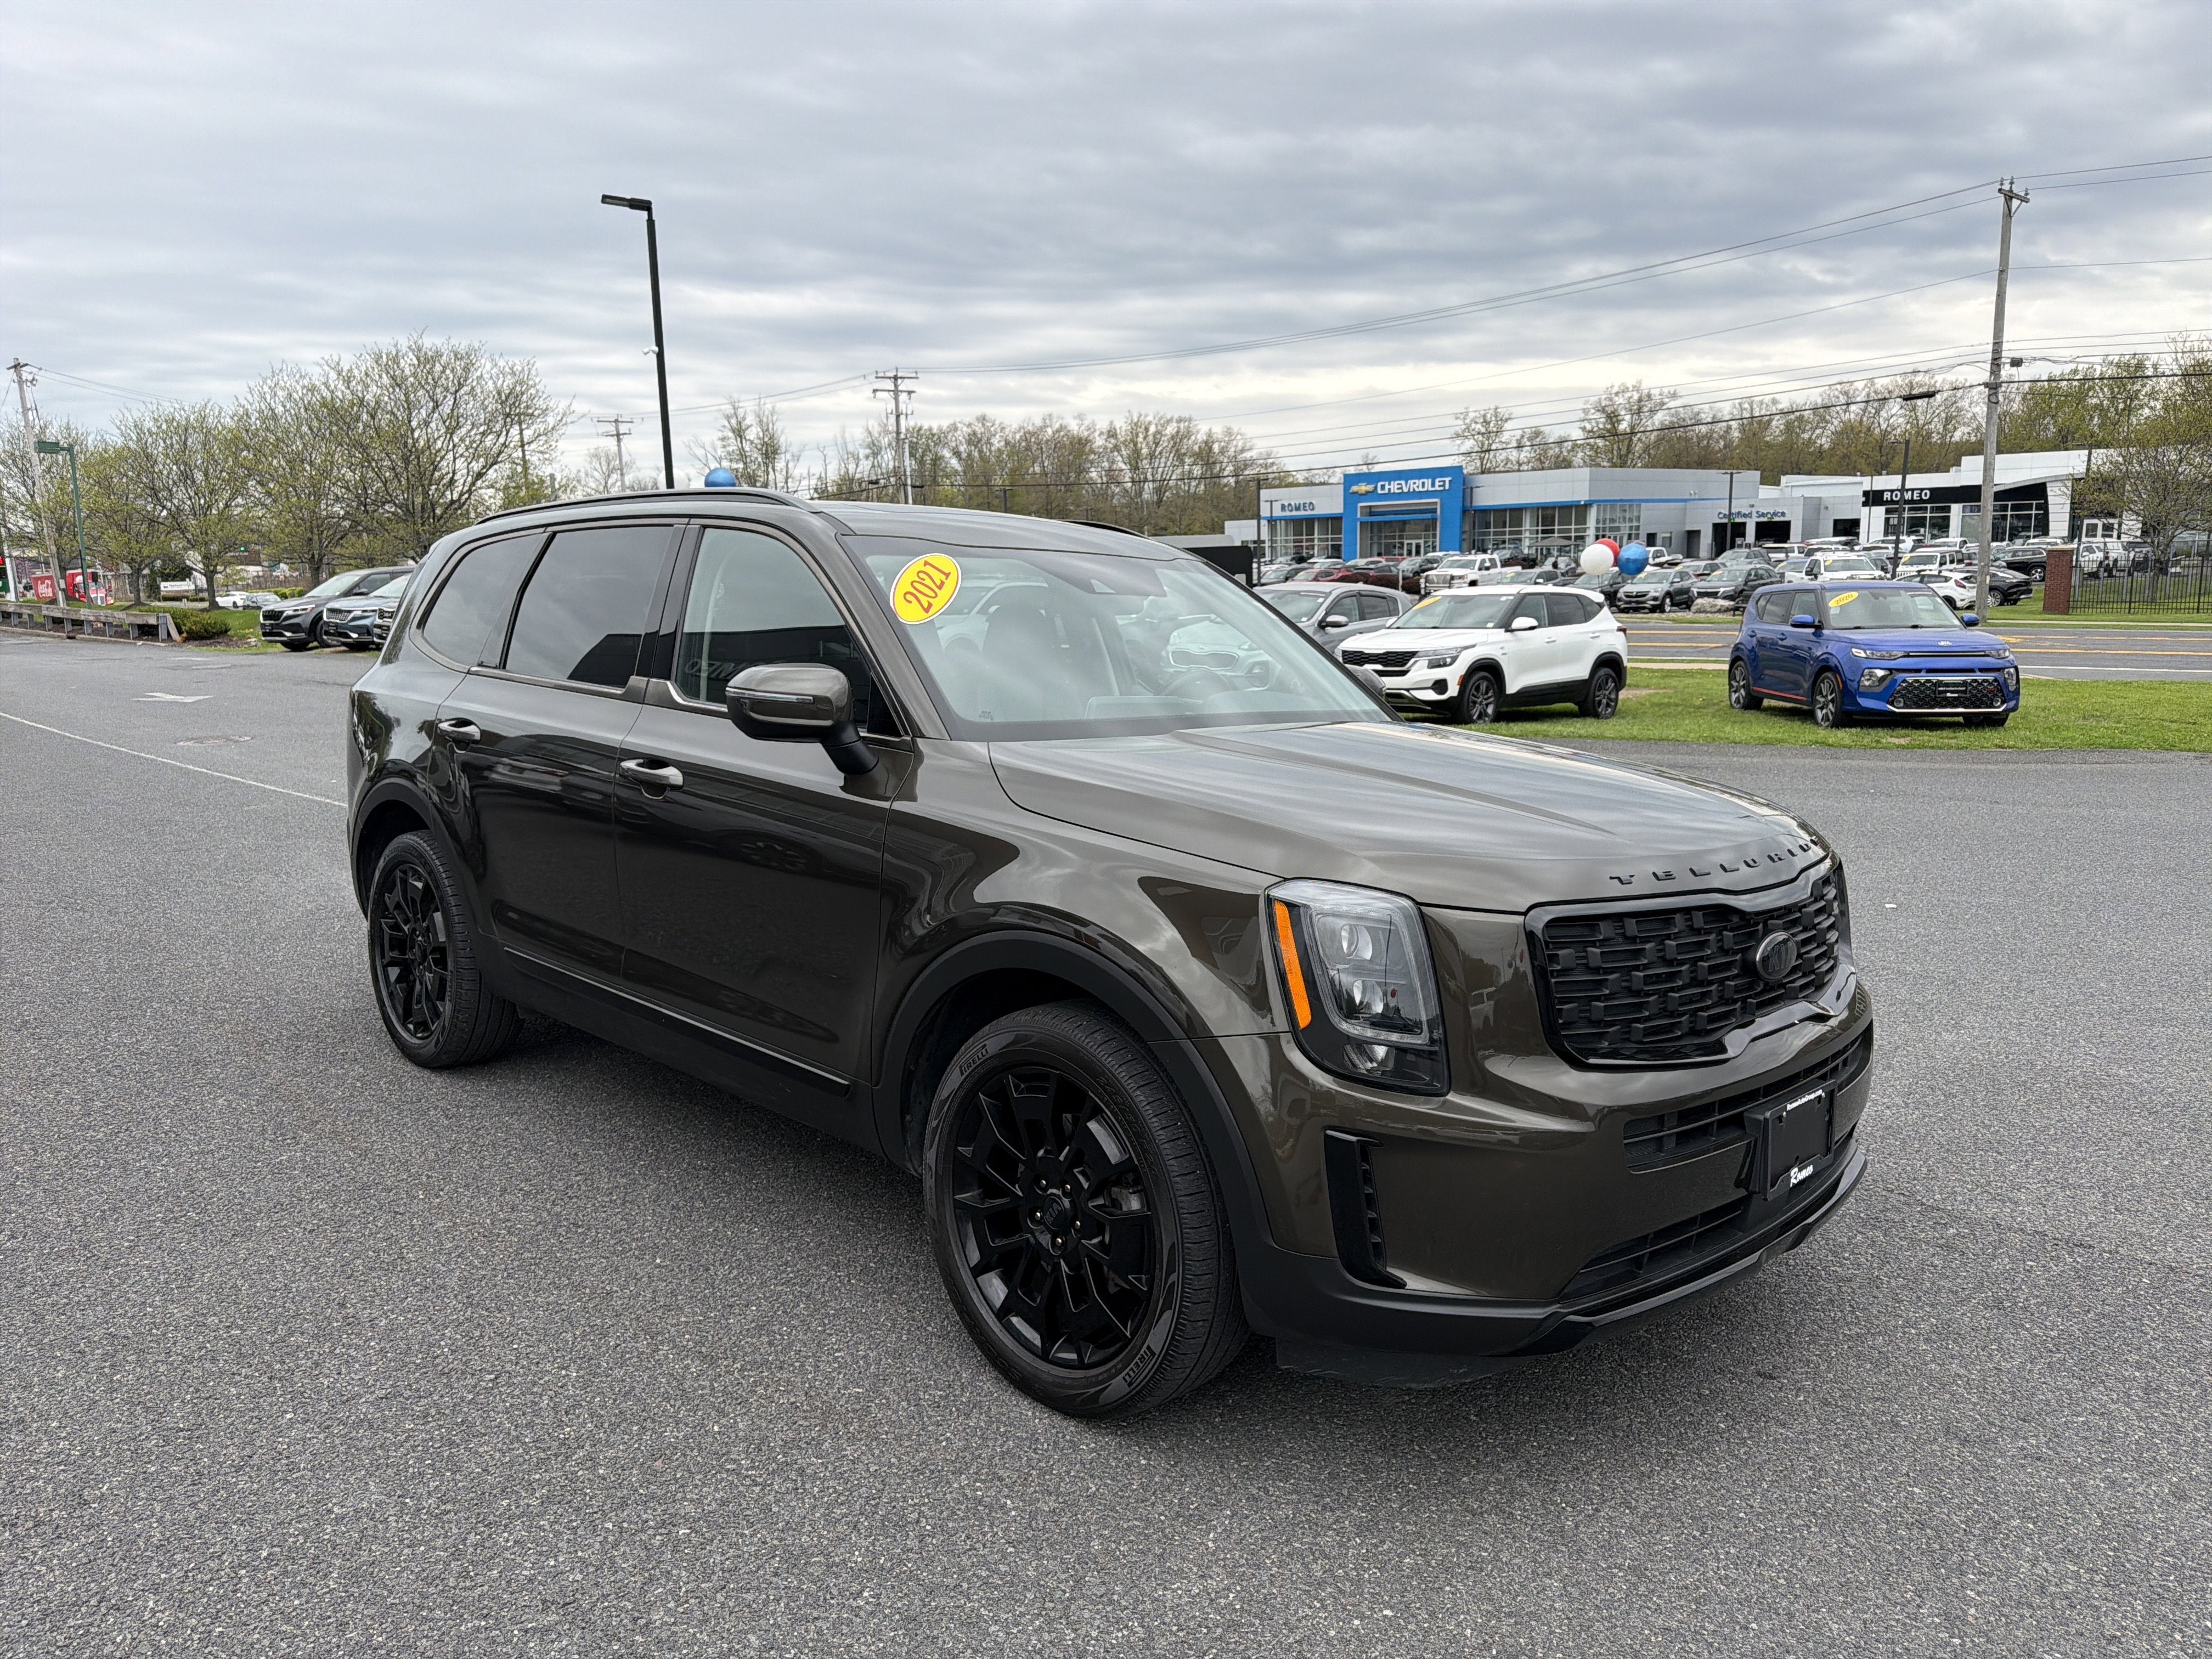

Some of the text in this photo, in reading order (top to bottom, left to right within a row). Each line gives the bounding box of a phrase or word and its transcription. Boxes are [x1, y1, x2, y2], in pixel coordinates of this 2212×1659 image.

[1377, 477, 1452, 494] CHEVROLET
[1883, 489, 1931, 501] ROMEO
[1280, 501, 1315, 512] ROMEO
[1717, 509, 1786, 520] Cetified Service
[903, 560, 951, 614] 2021
[1834, 594, 1853, 605] 2020
[958, 1043, 989, 1077] PIRELLI
[1790, 1164, 1813, 1188] Romeo
[1045, 1202, 1062, 1224] KIA
[1122, 1344, 1157, 1389] PIRELLI
